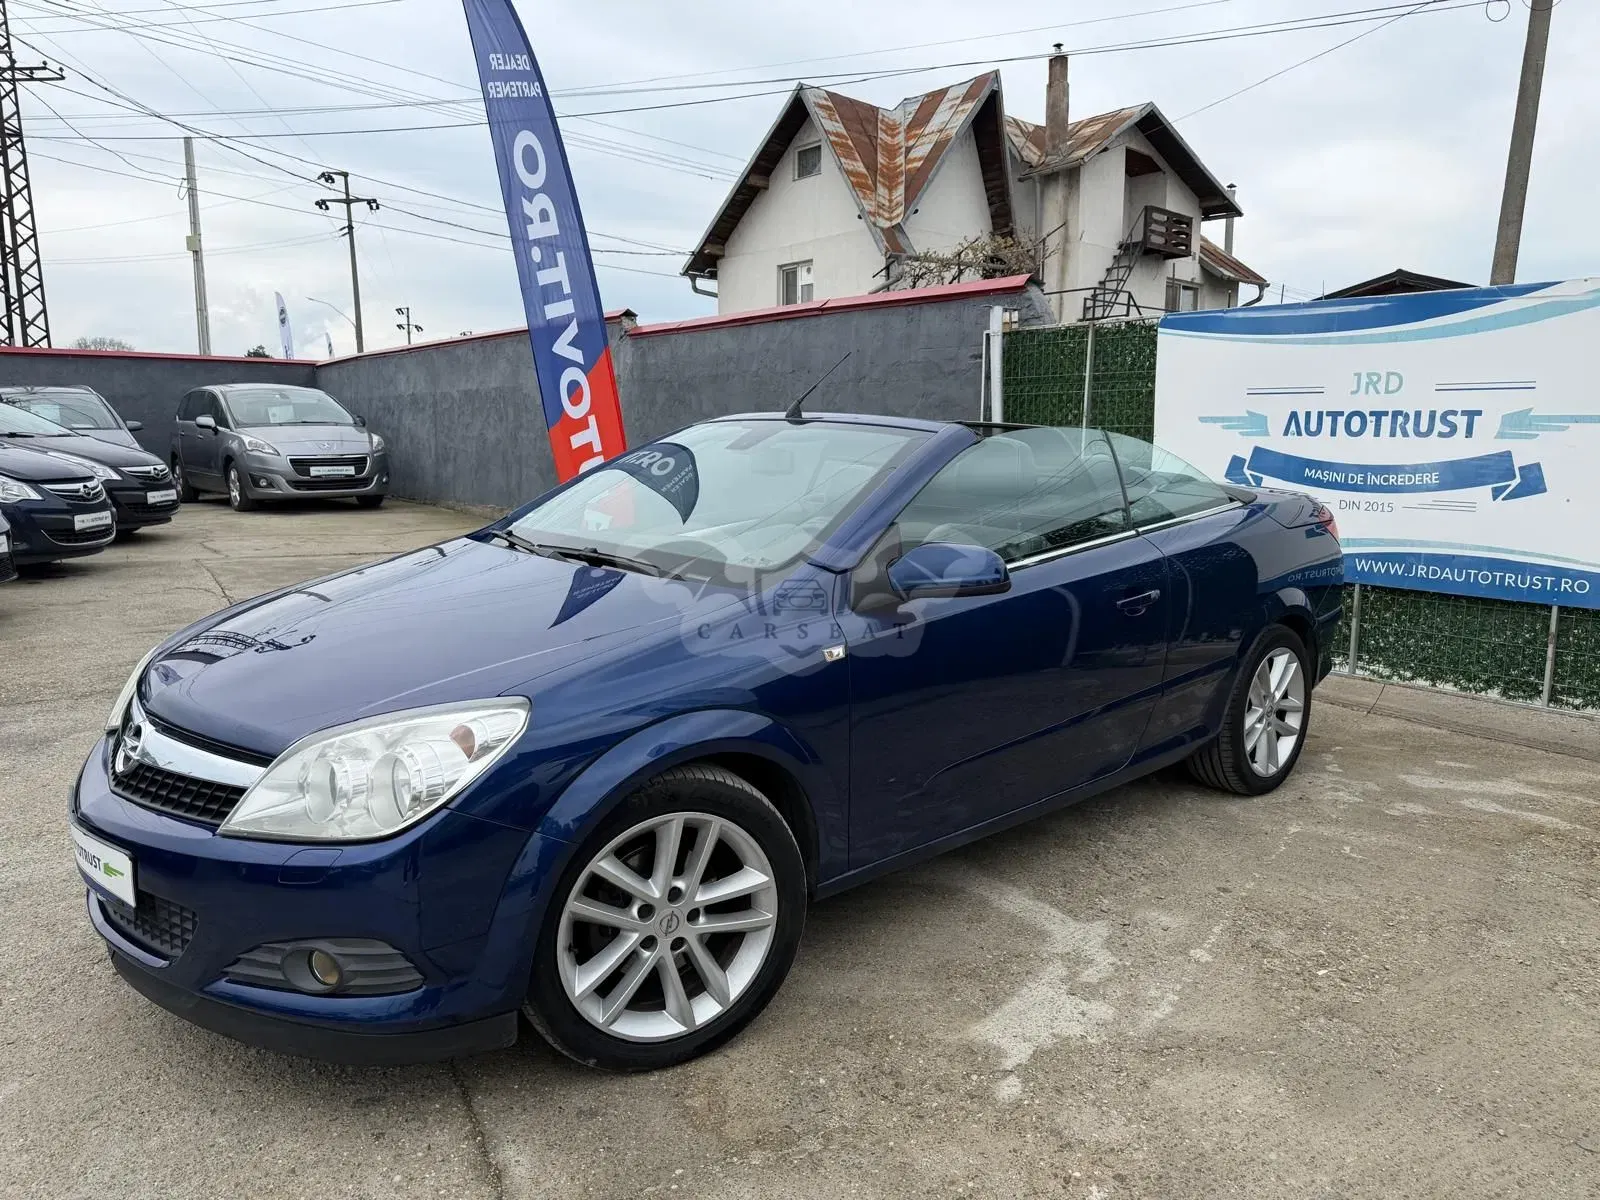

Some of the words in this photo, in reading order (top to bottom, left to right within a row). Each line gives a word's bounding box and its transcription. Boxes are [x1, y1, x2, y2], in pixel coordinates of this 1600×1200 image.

[1349, 371, 1404, 395] JRD
[1282, 409, 1483, 439] AUTOTRUST
[1304, 467, 1345, 484] MAȘINI
[1348, 474, 1364, 485] DE
[1367, 472, 1440, 486] ÎNCREDERE
[1339, 499, 1361, 511] DIN
[1364, 501, 1394, 513] 2015
[1355, 558, 1590, 594] WWW.JRDAUTOTRUST.RO
